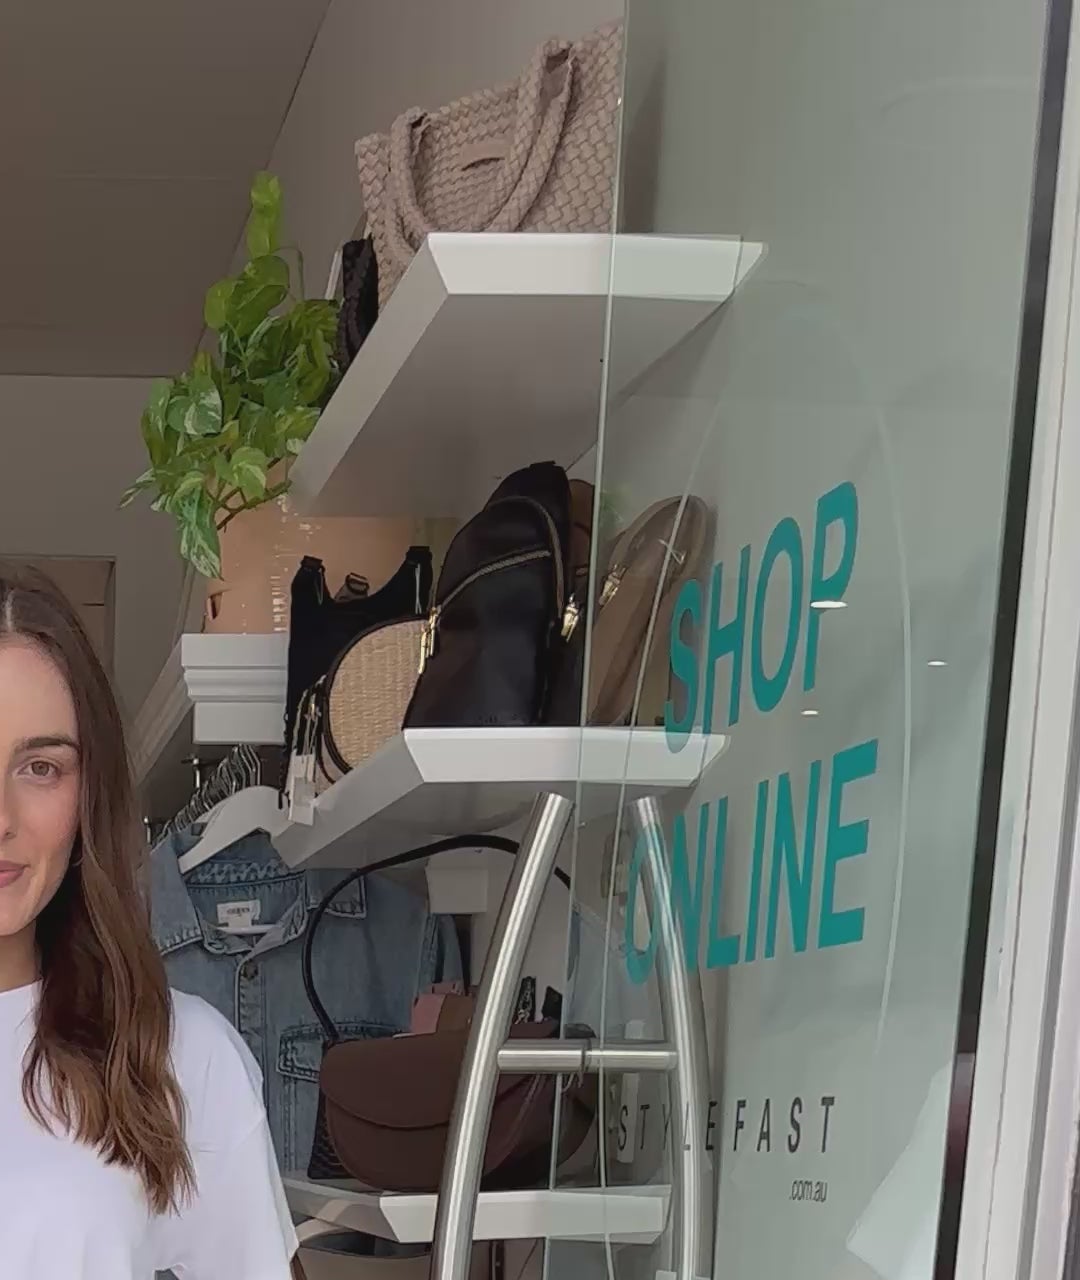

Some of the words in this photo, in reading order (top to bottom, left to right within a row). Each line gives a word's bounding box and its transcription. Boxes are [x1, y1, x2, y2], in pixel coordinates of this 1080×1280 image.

[664, 481, 858, 753] SHOP
[625, 738, 878, 985] ONLINE
[618, 1096, 834, 1153] STYLEFAST
